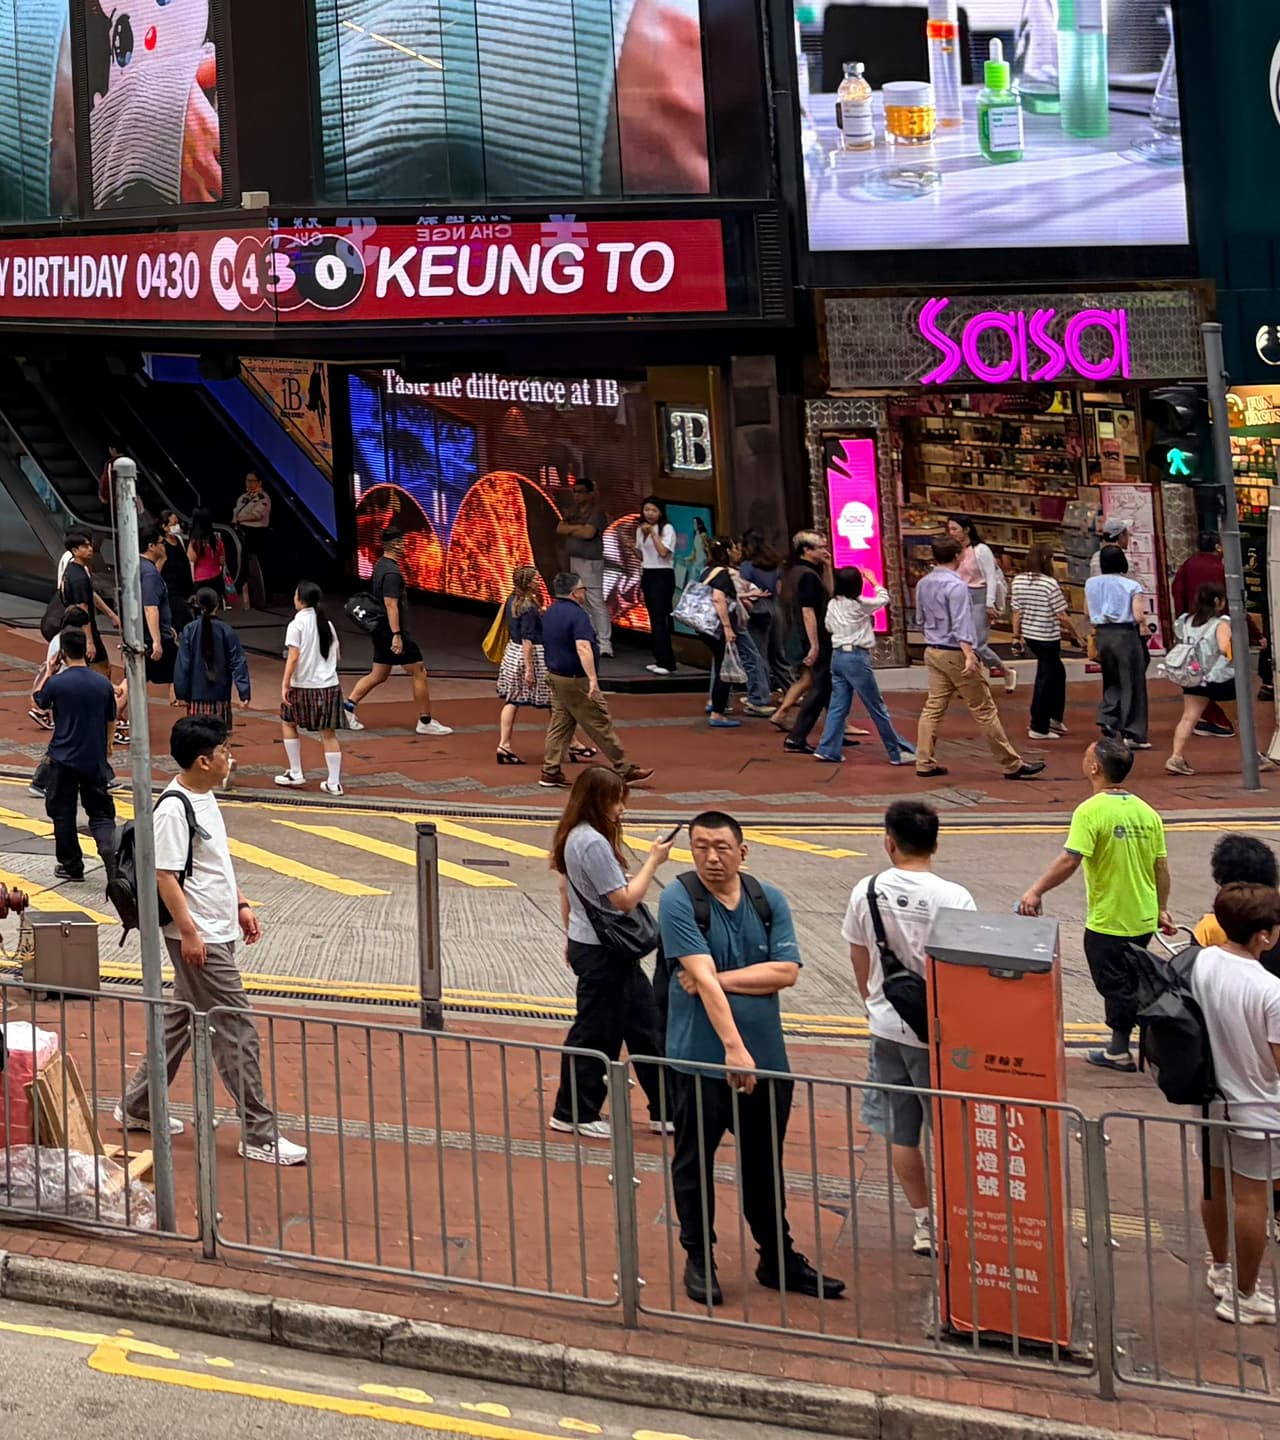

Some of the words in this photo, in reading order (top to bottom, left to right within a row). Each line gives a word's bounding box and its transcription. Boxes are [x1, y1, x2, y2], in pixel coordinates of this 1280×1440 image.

[13, 254, 128, 299] BIRTHDAY
[136, 251, 200, 300] 0430
[375, 243, 585, 299] KEUNG
[596, 240, 676, 294] TO
[466, 372, 565, 403] difference
[571, 378, 592, 405] at
[596, 378, 620, 407] IB
[1246, 396, 1273, 410] FUN
[669, 410, 713, 470] iB
[984, 1053, 1024, 1068] 運輸署
[974, 1103, 1000, 1198] 遵照燈號
[1005, 1107, 1027, 1202] 小心過路
[1016, 1282, 1040, 1295] BILL
